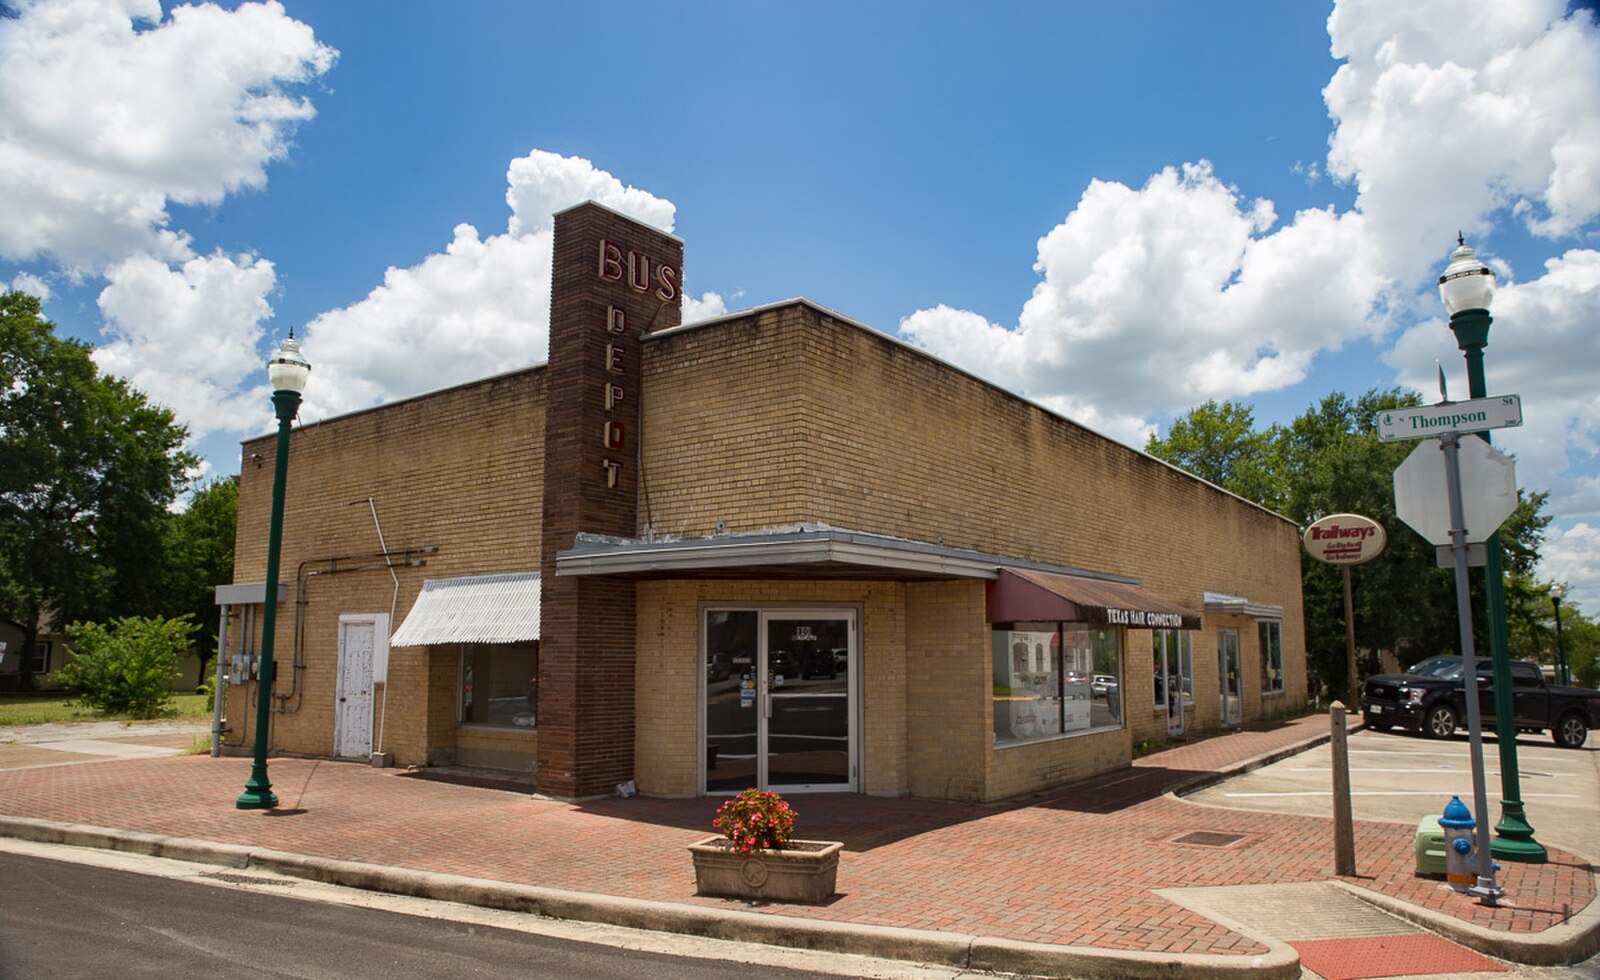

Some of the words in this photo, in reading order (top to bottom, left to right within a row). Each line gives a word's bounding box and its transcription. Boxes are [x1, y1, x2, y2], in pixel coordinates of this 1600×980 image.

[598, 239, 678, 301] BUS
[603, 305, 626, 488] DEPOT
[1409, 410, 1487, 430] Thompson
[1502, 397, 1514, 406] St
[1311, 525, 1376, 541] Trailways
[1107, 608, 1129, 624] TEXAS
[1130, 610, 1146, 625] HAIR
[1147, 612, 1182, 627] CONNECTION
